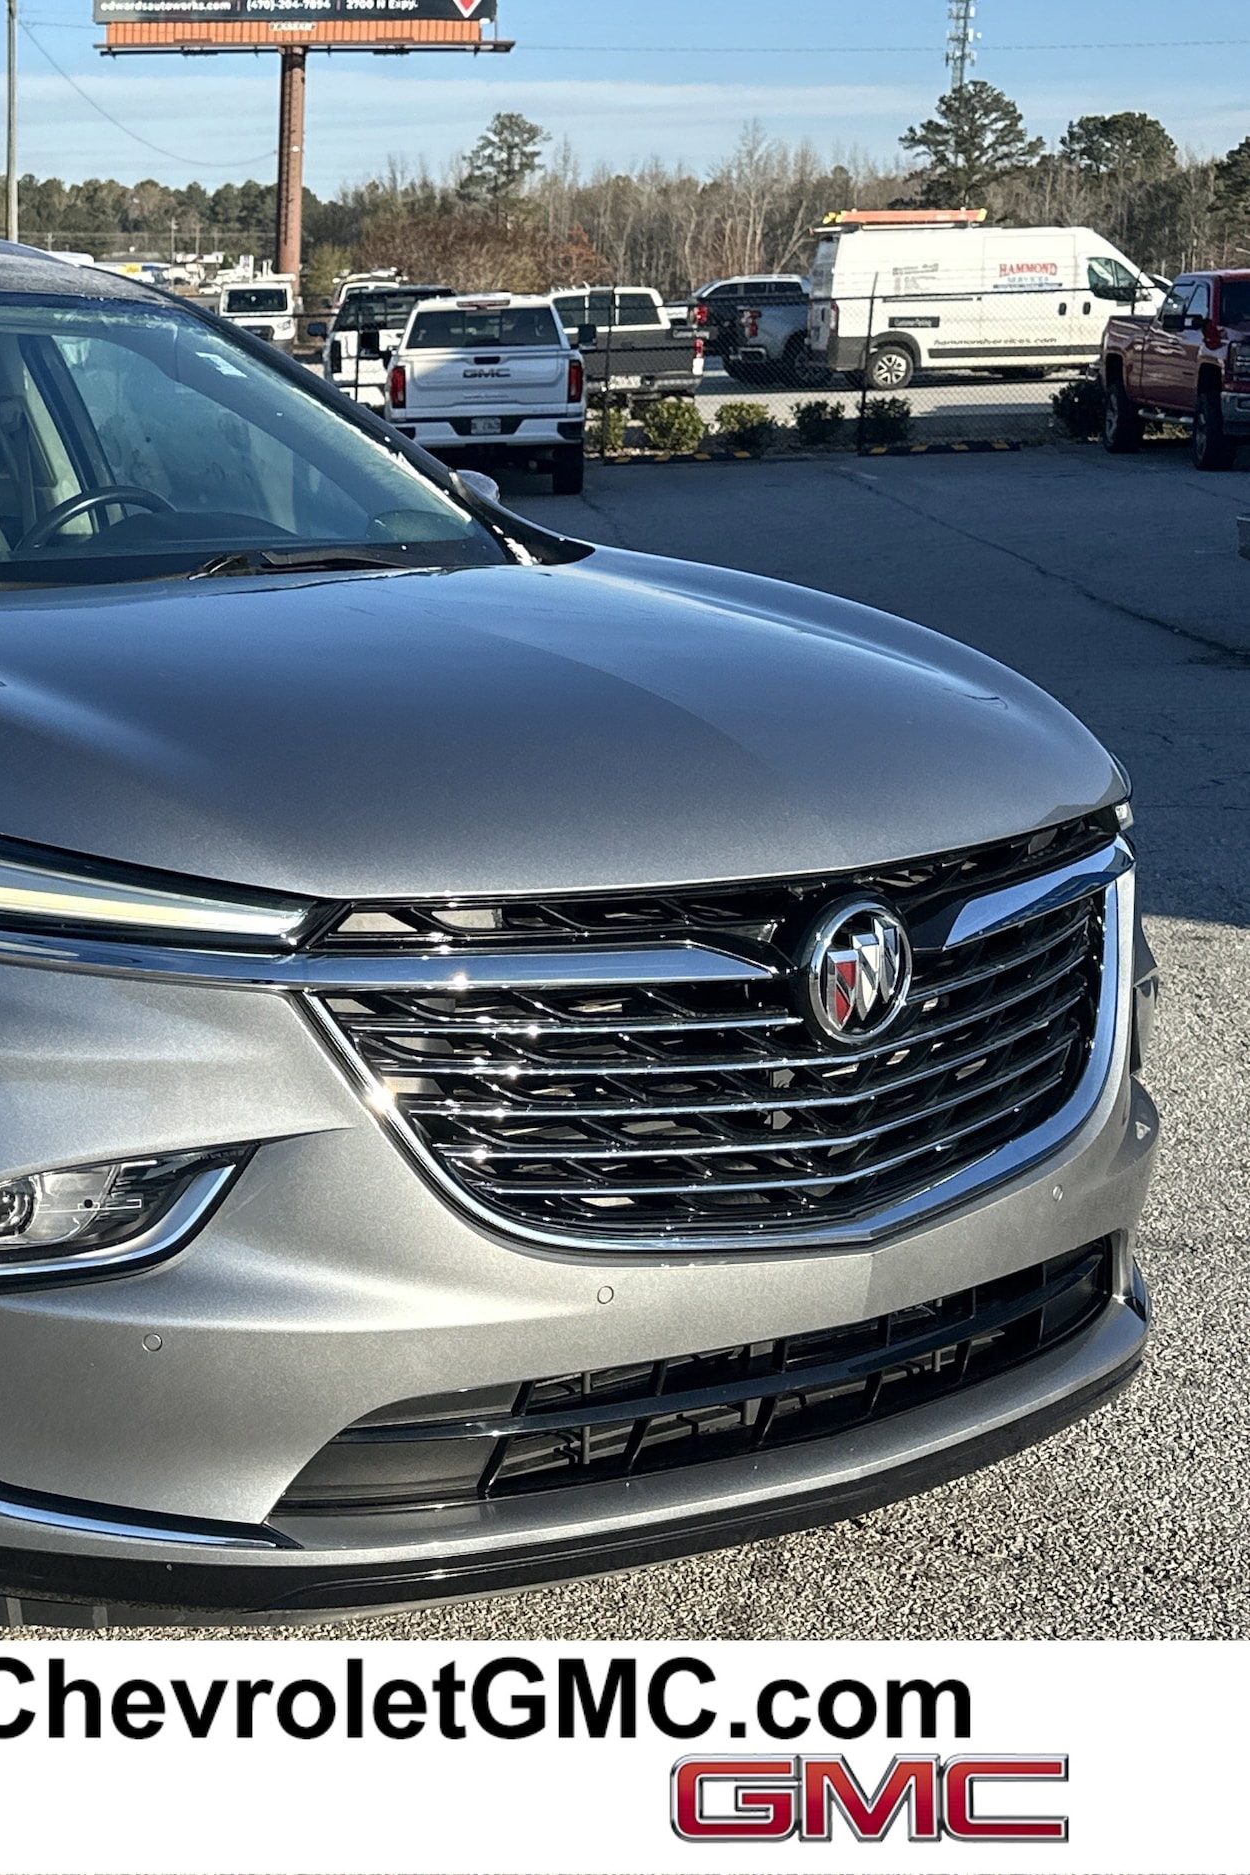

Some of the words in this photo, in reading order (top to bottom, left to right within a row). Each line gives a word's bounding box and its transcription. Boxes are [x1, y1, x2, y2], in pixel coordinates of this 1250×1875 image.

[100, 1, 231, 11] edwardsautoworks.com
[246, 0, 331, 11] (470)-204-7894
[999, 263, 1058, 277] HAMMOND
[463, 368, 511, 378] GMC
